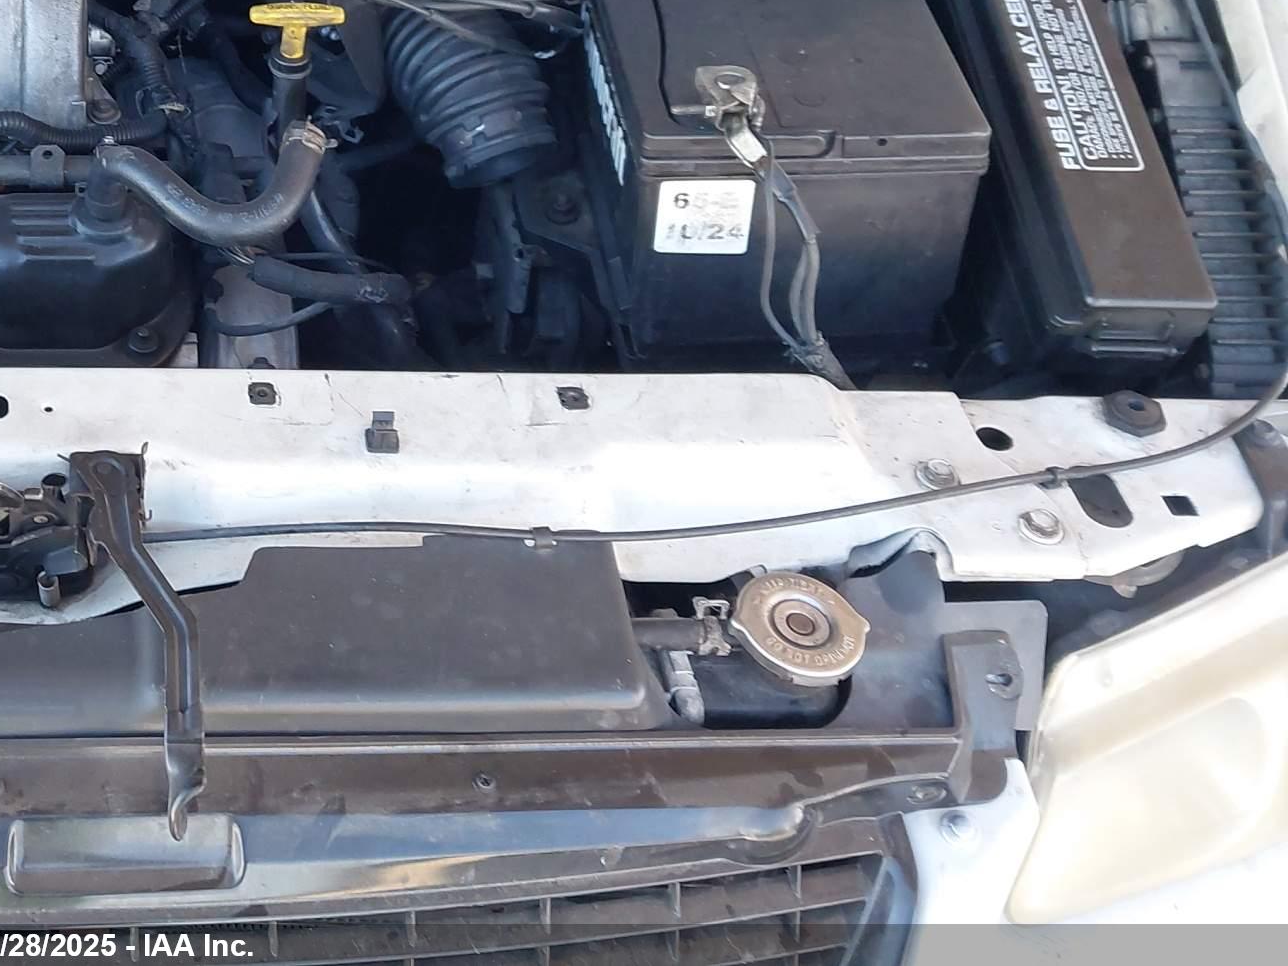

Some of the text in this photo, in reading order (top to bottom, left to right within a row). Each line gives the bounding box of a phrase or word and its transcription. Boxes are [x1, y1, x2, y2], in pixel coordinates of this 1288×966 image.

[1032, 4, 1050, 29] AVOID
[1045, 12, 1061, 30] NOT
[1042, 32, 1059, 54] HELP
[1015, 32, 1053, 92] RELAY
[1052, 58, 1064, 69] TO
[1042, 98, 1059, 110] &
[1067, 72, 1091, 111] AND/OR
[1055, 75, 1099, 159] CAUTION!
[1046, 116, 1081, 168] FUSE
